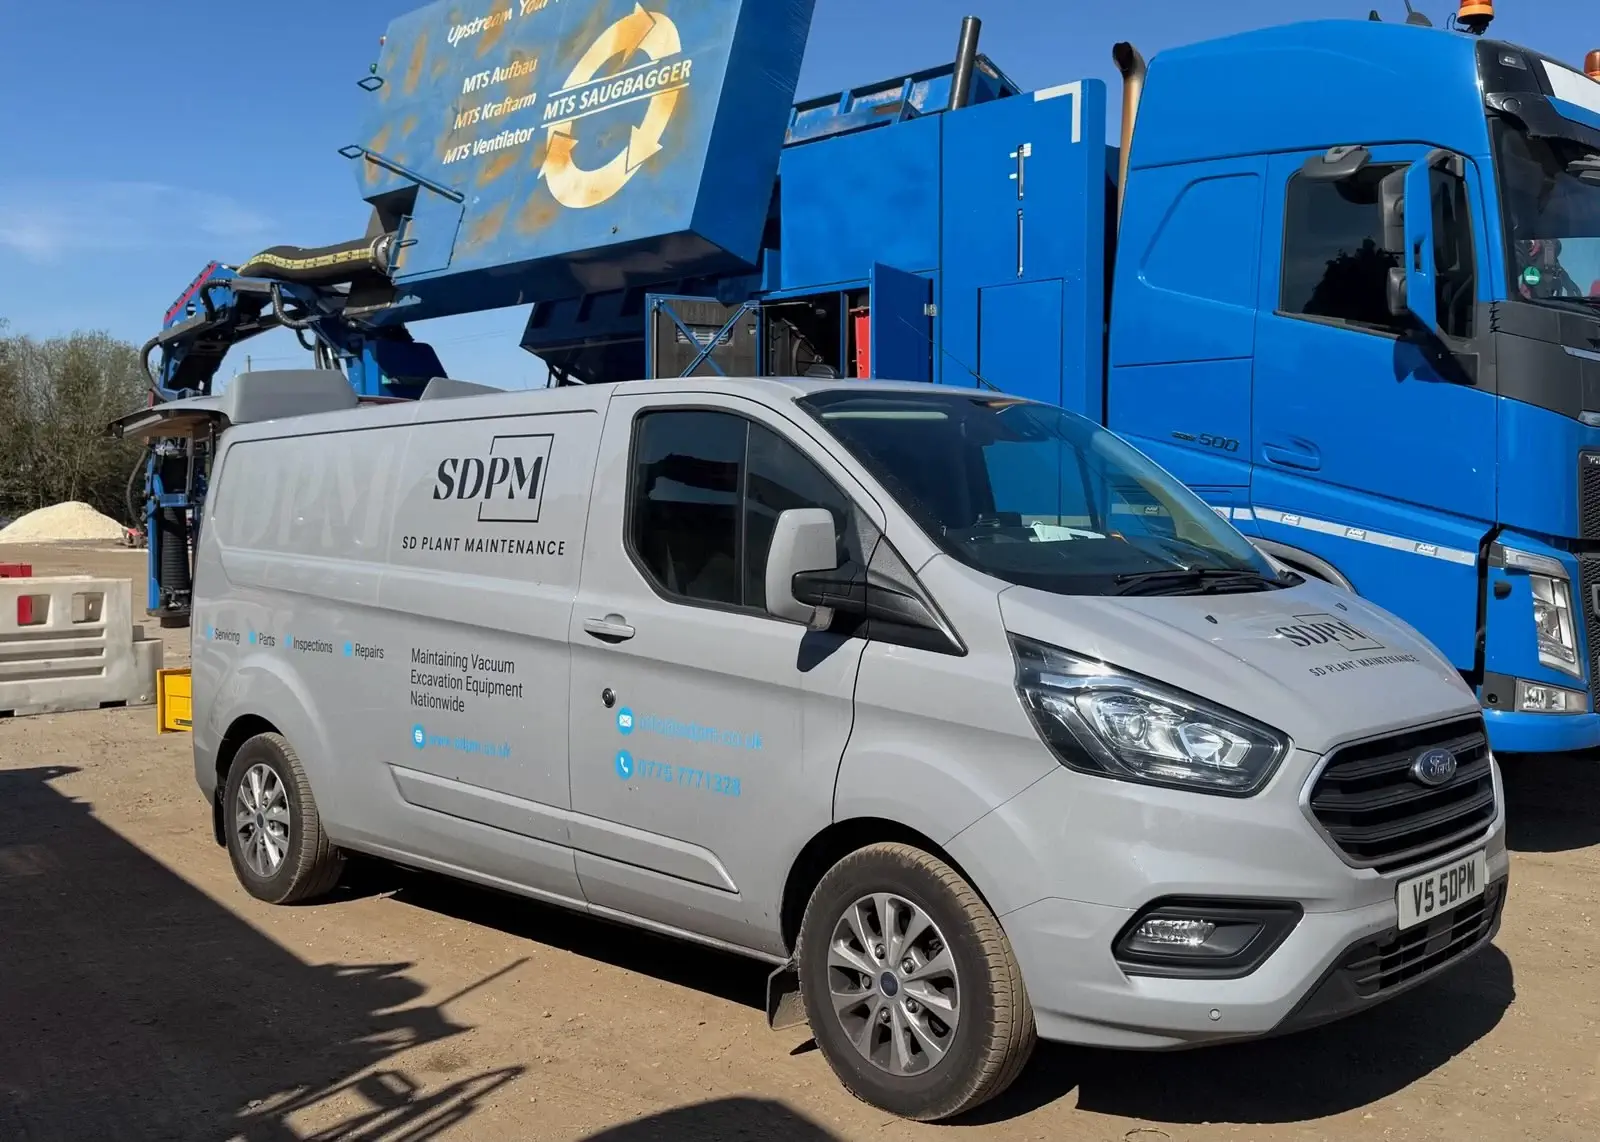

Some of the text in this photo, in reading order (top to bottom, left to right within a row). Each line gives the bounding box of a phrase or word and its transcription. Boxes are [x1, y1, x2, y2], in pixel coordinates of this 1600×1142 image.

[447, 8, 512, 47] Upstream
[462, 58, 538, 94] MTS Aufbau
[543, 59, 692, 121] MTS SAUGBAGGER
[453, 92, 537, 130] MTS Kraftarm
[442, 127, 535, 165] MTS Ventilator
[1199, 433, 1240, 452] 500
[433, 456, 544, 500] SDPM
[402, 535, 565, 556] SD PLANT MAINTENANCE
[214, 628, 241, 645] Servicing
[258, 632, 275, 647] Parts
[293, 636, 333, 654] Inspections
[1275, 621, 1367, 647] SDPM
[355, 643, 385, 660] Repairs
[411, 647, 515, 674] Maintaining Vacuum
[1309, 654, 1420, 677] SD PLANT MAINTENANCE
[410, 669, 523, 698] Excavation Equipment
[410, 690, 465, 713] Nationwide
[638, 759, 673, 783] 0775
[1430, 754, 1451, 776] Ford
